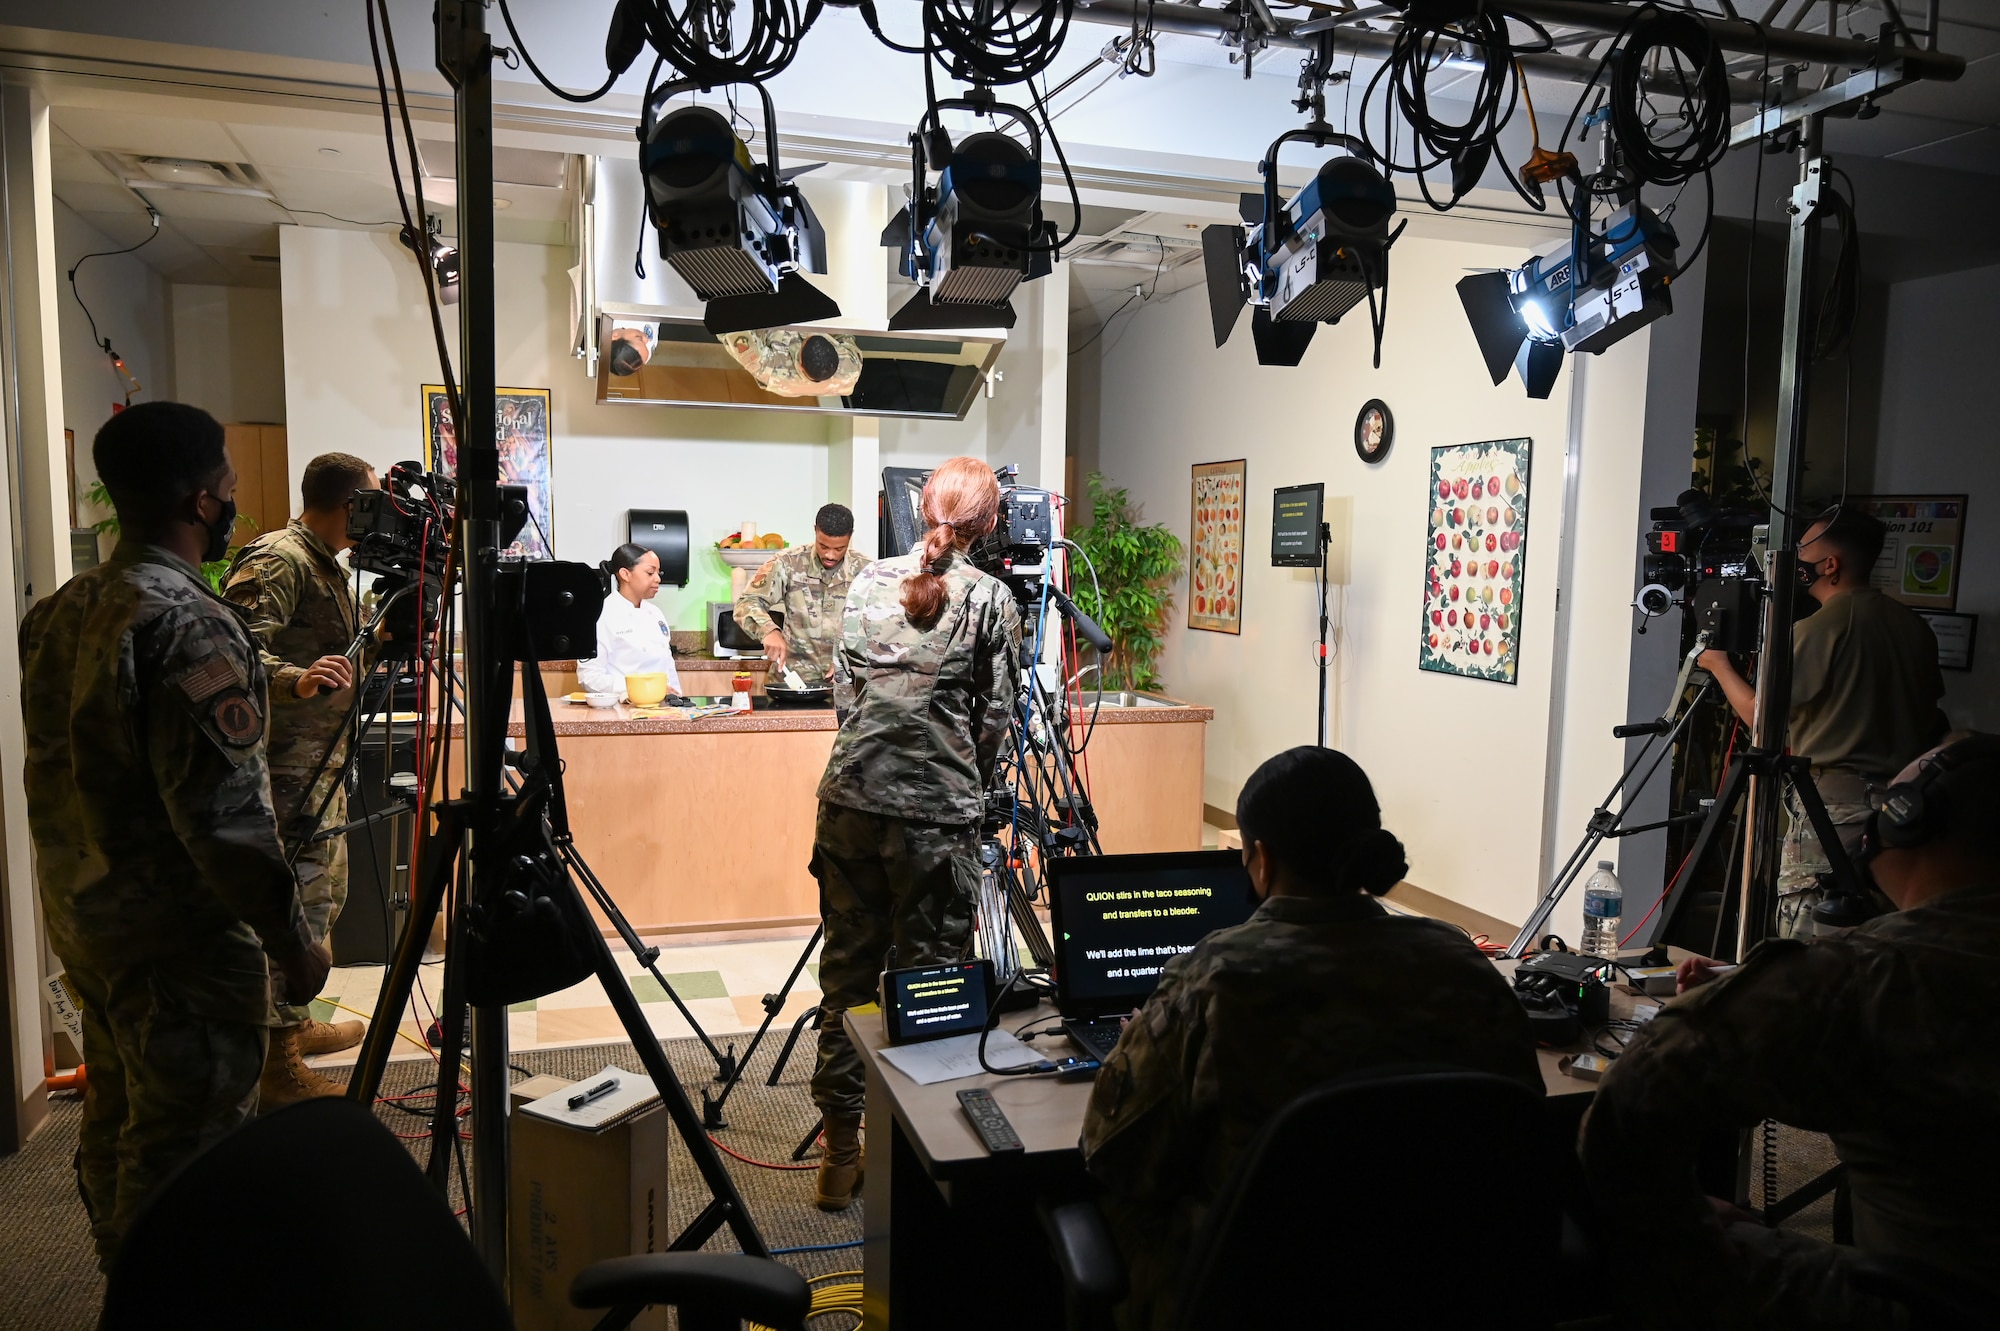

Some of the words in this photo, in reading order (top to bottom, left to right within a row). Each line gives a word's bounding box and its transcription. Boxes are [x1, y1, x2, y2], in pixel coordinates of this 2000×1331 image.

[1908, 521, 1933, 532] 101
[1662, 534, 1671, 546] 3
[1086, 892, 1114, 902] QUION
[1116, 891, 1132, 900] stirs
[1134, 890, 1142, 898] in
[1142, 890, 1154, 898] the
[1156, 890, 1172, 898] taco
[1174, 887, 1212, 897] seasoning
[1102, 911, 1118, 920] and
[1119, 909, 1152, 918] transfers
[1154, 909, 1162, 917] to
[1170, 907, 1200, 916] blender.
[1086, 950, 1106, 960] We'll
[1107, 949, 1122, 958] add
[1124, 948, 1136, 957] the
[1138, 947, 1154, 956] lime
[1156, 946, 1176, 955] that's
[1107, 968, 1122, 978] and
[1131, 966, 1158, 978] quarter
